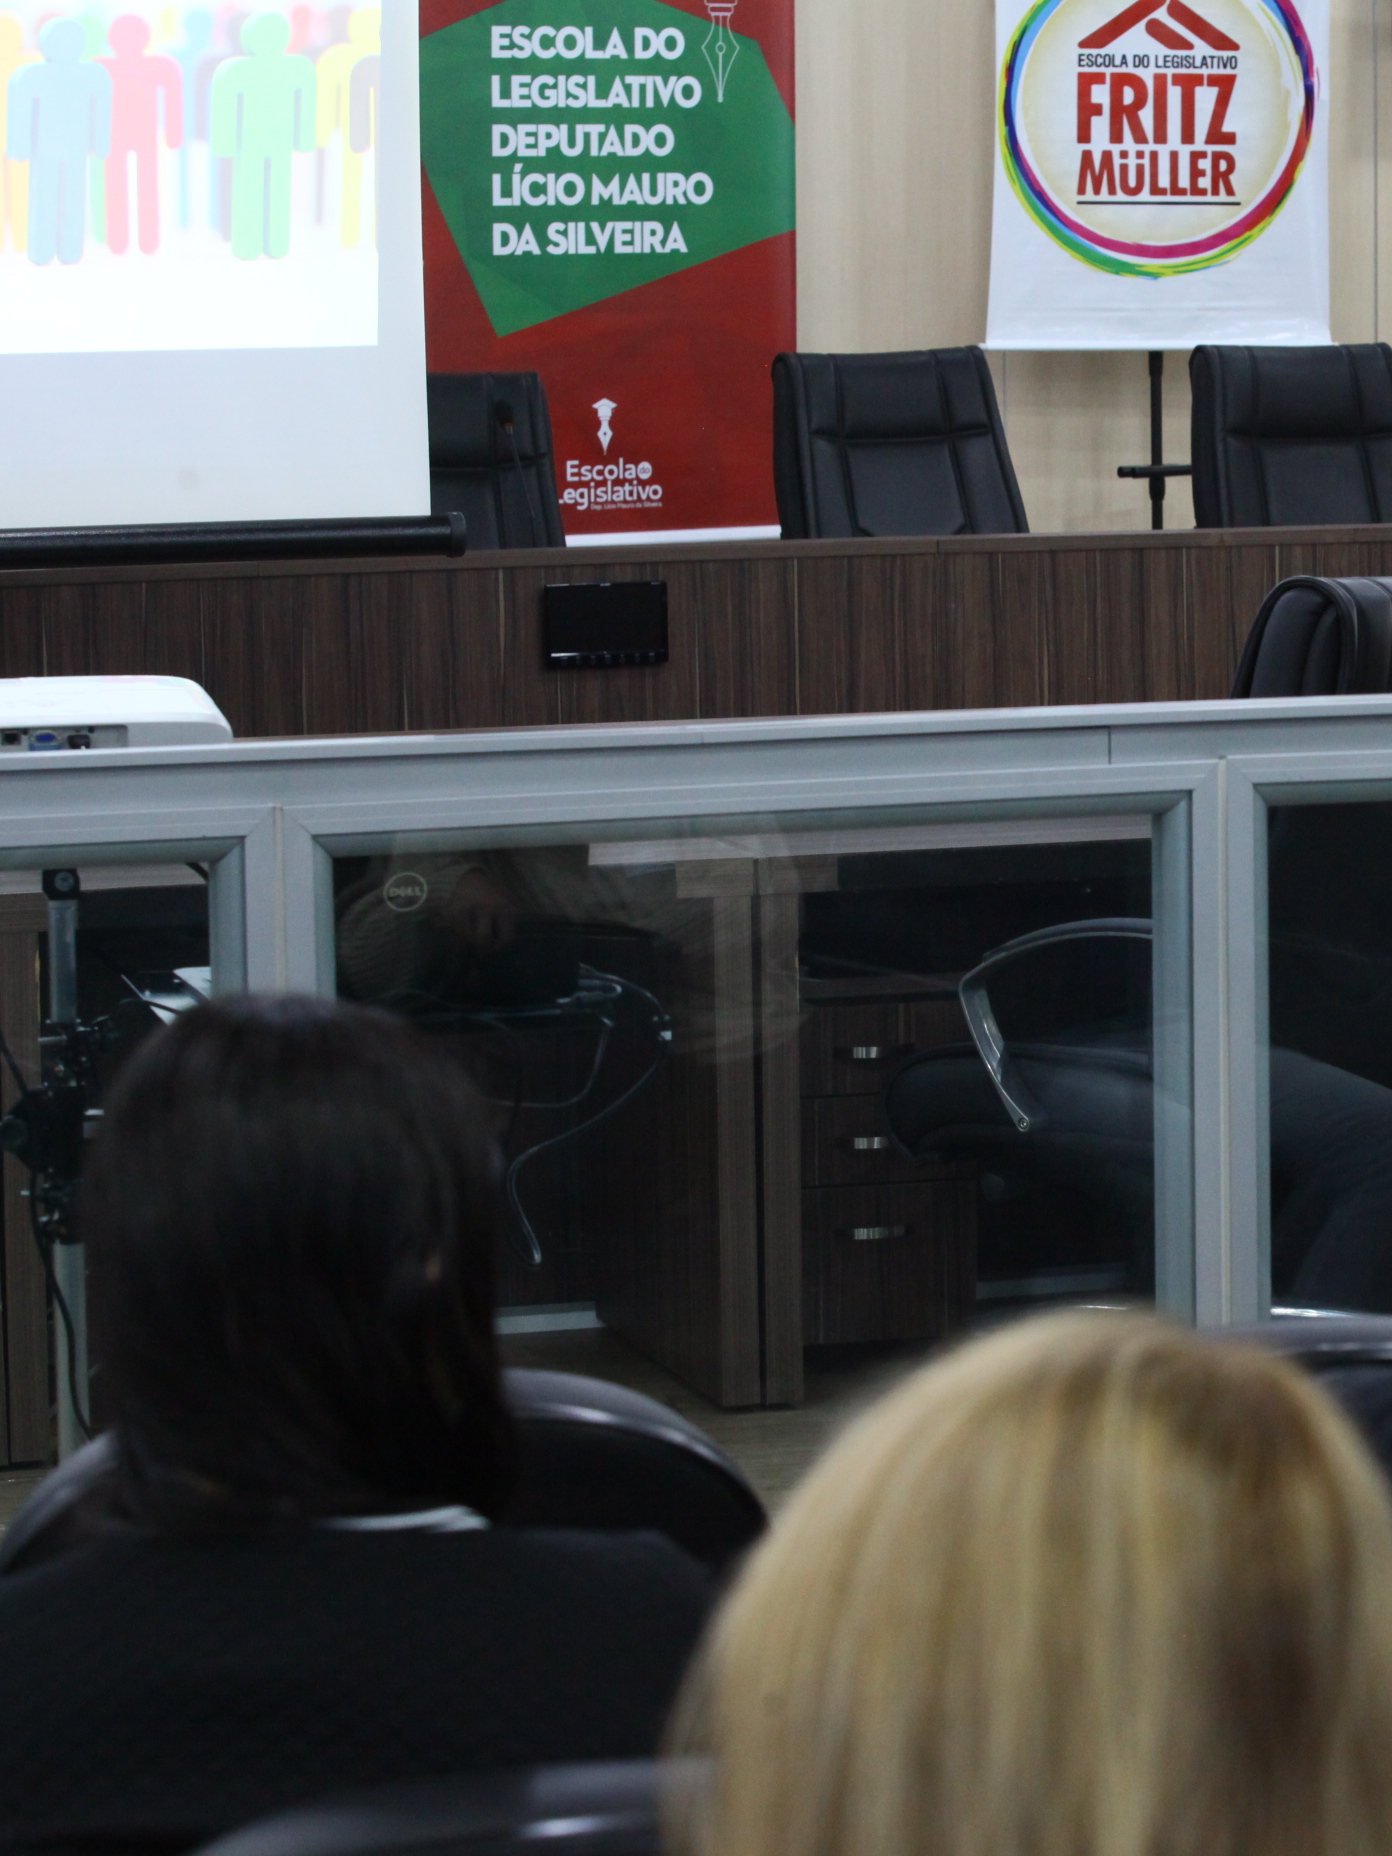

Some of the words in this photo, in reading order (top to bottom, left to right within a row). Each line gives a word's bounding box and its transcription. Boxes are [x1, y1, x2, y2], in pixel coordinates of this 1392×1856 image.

[491, 25, 628, 59] ESCOLA
[634, 27, 685, 60] DO
[1078, 53, 1128, 68] ESCOLA
[1133, 54, 1149, 68] DO
[1155, 54, 1238, 70] LEGISLATIVO
[491, 75, 702, 108] LEGISLATIVO
[1077, 72, 1237, 145] FRITZ
[492, 124, 675, 157] DEPUTADO
[492, 163, 585, 206] LÍCIO
[591, 171, 714, 205] MAURO
[1077, 149, 1236, 197] MÜLLER
[492, 222, 541, 256] DA
[546, 220, 688, 255] SILVEIRA
[566, 457, 636, 482] Escola
[639, 466, 651, 475] do
